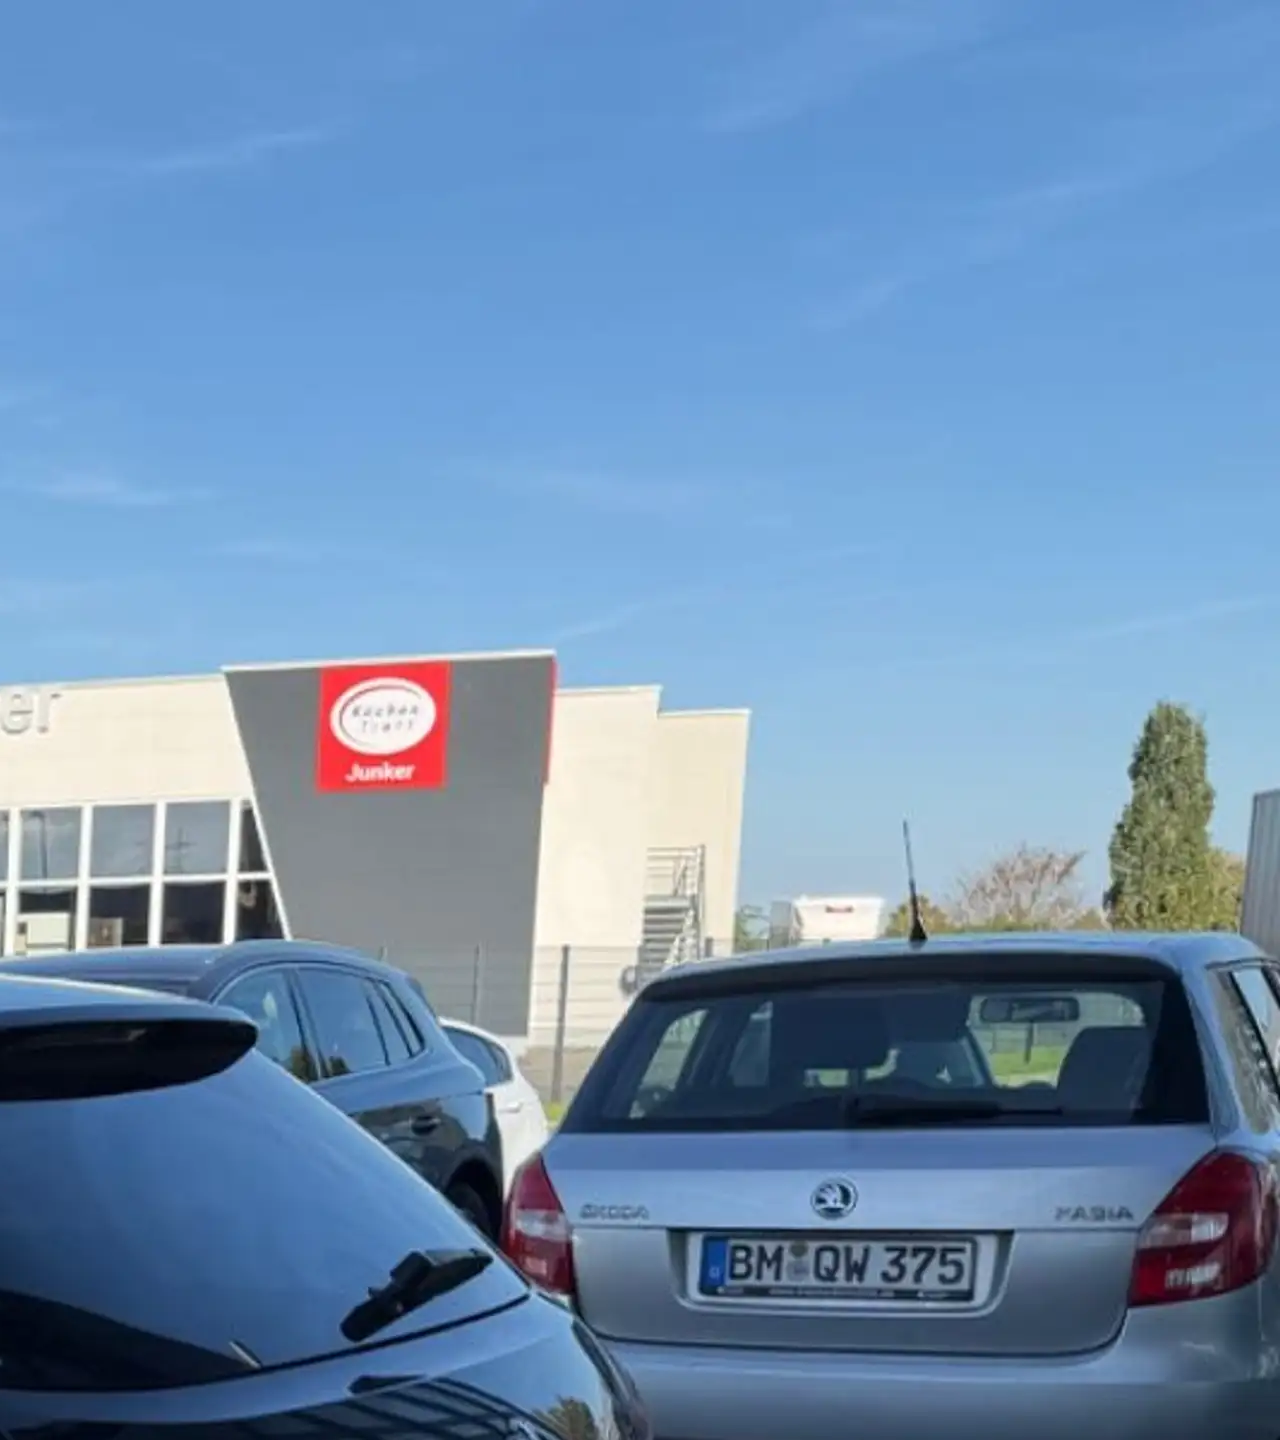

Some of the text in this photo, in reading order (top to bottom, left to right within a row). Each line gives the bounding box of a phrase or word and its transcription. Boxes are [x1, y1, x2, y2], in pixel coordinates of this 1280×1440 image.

[344, 761, 416, 783] Junker
[727, 1245, 968, 1286] BM QW 375
